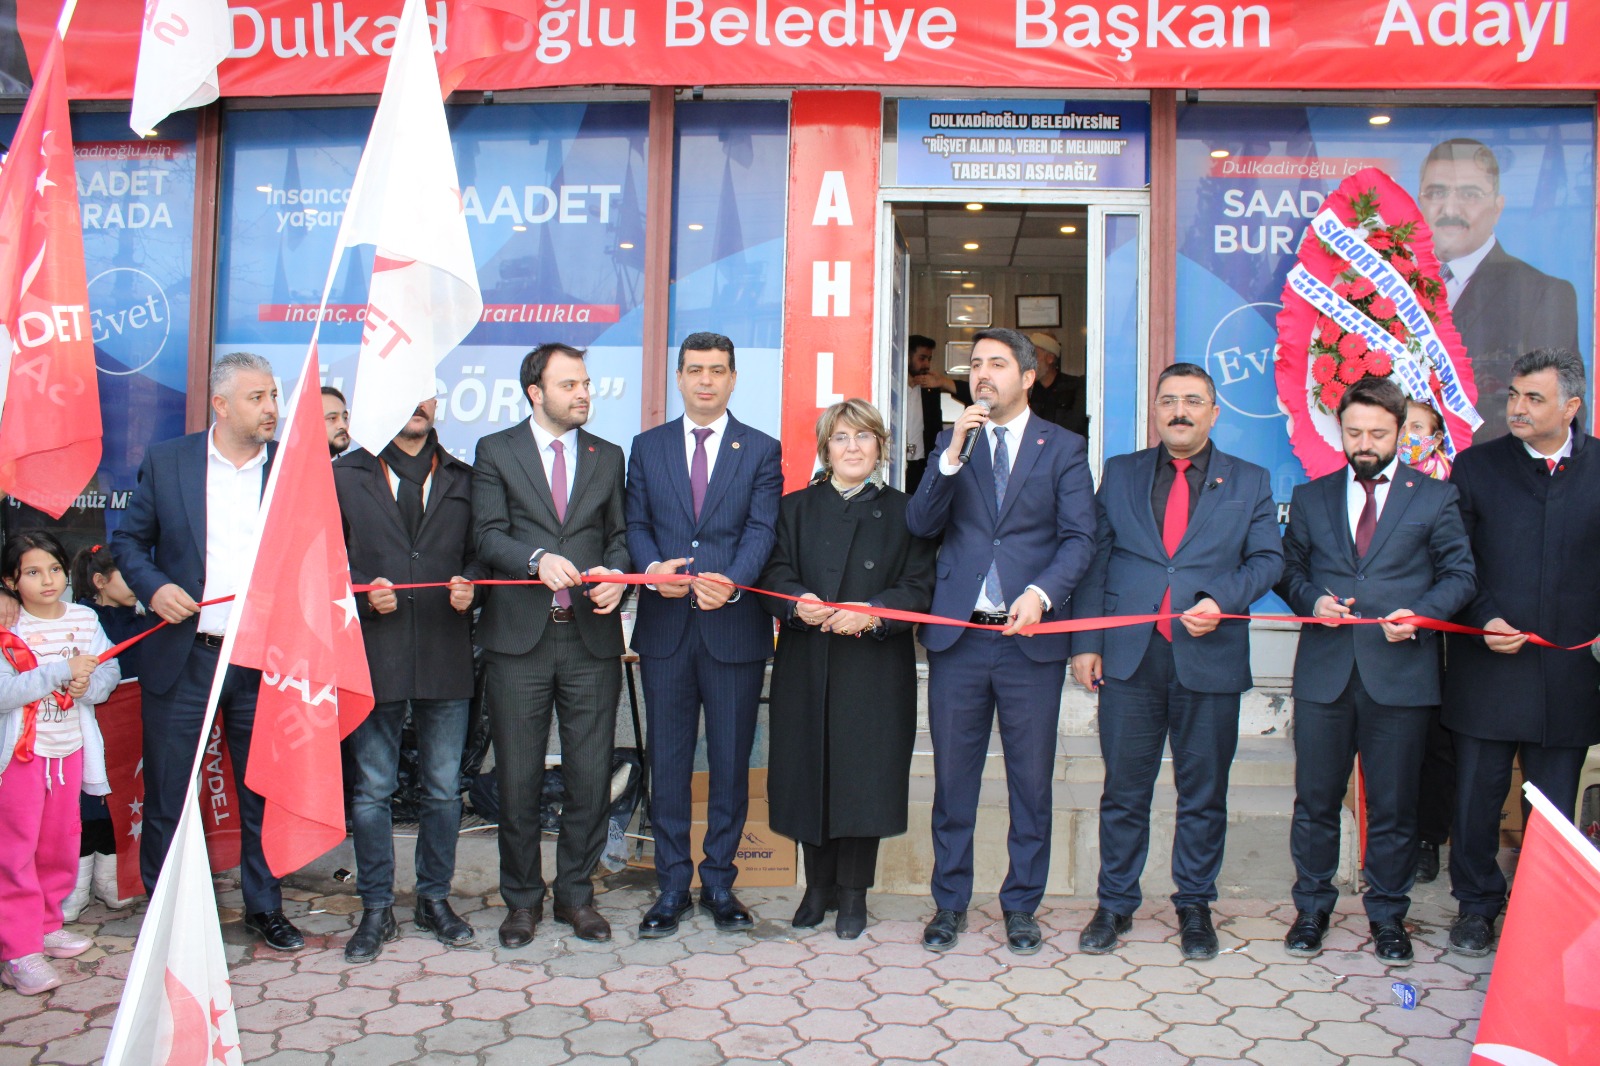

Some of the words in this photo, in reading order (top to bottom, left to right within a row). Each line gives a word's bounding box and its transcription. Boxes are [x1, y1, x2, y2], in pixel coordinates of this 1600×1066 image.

[227, 0, 636, 64] Dulkadğlu
[665, 0, 957, 61] Belediye
[1015, 0, 1271, 61] Başkan
[1374, 0, 1568, 62] Adayı
[931, 111, 1028, 129] DULKADİROĞLU
[1031, 112, 1120, 130] BELEDİYESİNE
[73, 145, 140, 160] kadiroğlu
[969, 138, 996, 154] ALAN
[998, 138, 1015, 155] DA,
[1016, 138, 1048, 154] VEREN
[1050, 139, 1063, 154] DE
[952, 163, 1020, 180] TABELASI
[1025, 161, 1097, 181] ASACAĞIZ
[1222, 160, 1336, 178] Dulkadiroğlu
[75, 170, 169, 197] ADET
[80, 203, 173, 229] RADA
[461, 185, 621, 224] AADET
[1223, 189, 1333, 218] SAAD
[1214, 224, 1308, 254] BUR
[90, 295, 164, 343] Evet
[482, 303, 590, 323] rarlılıkla
[1299, 270, 1405, 354] HAYIRLI
[1318, 218, 1431, 342] SİGORTACINIZ
[1425, 339, 1467, 413] OSMAN
[1213, 346, 1270, 386] Ev
